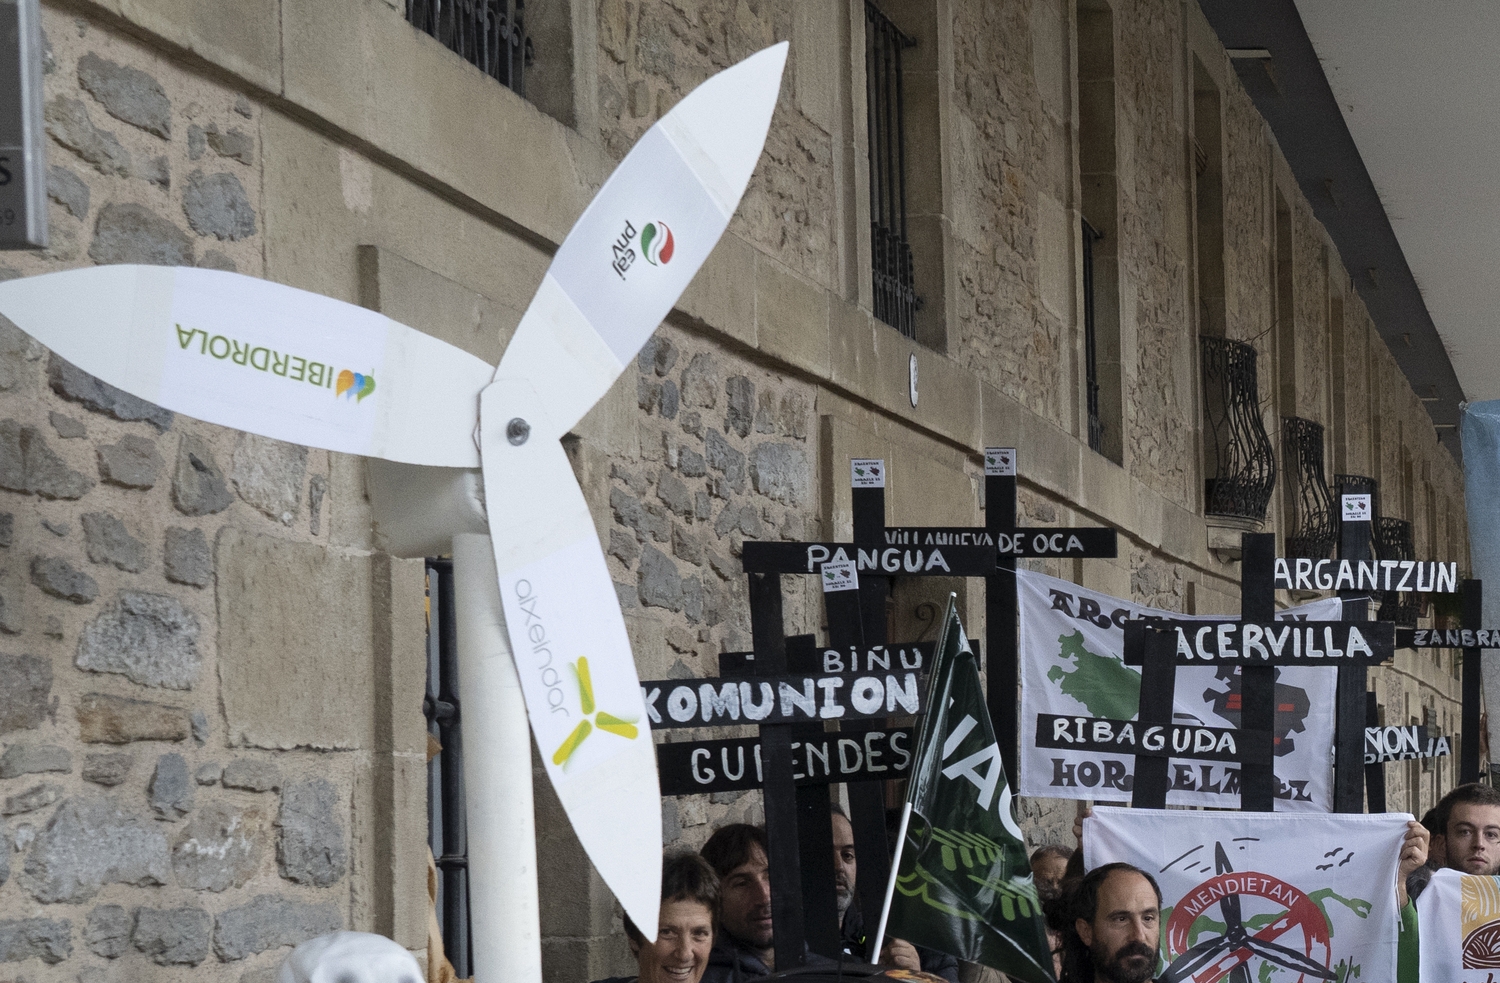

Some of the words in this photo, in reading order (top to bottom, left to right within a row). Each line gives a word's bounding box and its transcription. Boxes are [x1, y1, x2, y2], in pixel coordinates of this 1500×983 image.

[612, 220, 637, 260] pnv
[612, 248, 636, 281] eaj
[175, 323, 334, 389] IBERDROLA
[807, 544, 951, 573] PANGUA
[999, 532, 1023, 553] DE
[1034, 533, 1084, 553] OCA
[1274, 557, 1458, 594] ARGANTZUN
[514, 579, 570, 717] aixeindar
[1173, 623, 1373, 661] ACERVILLA
[639, 673, 920, 724] KOMUNION
[1053, 718, 1237, 754] RIBAGUDA
[1183, 877, 1299, 917] MENDIETAN
